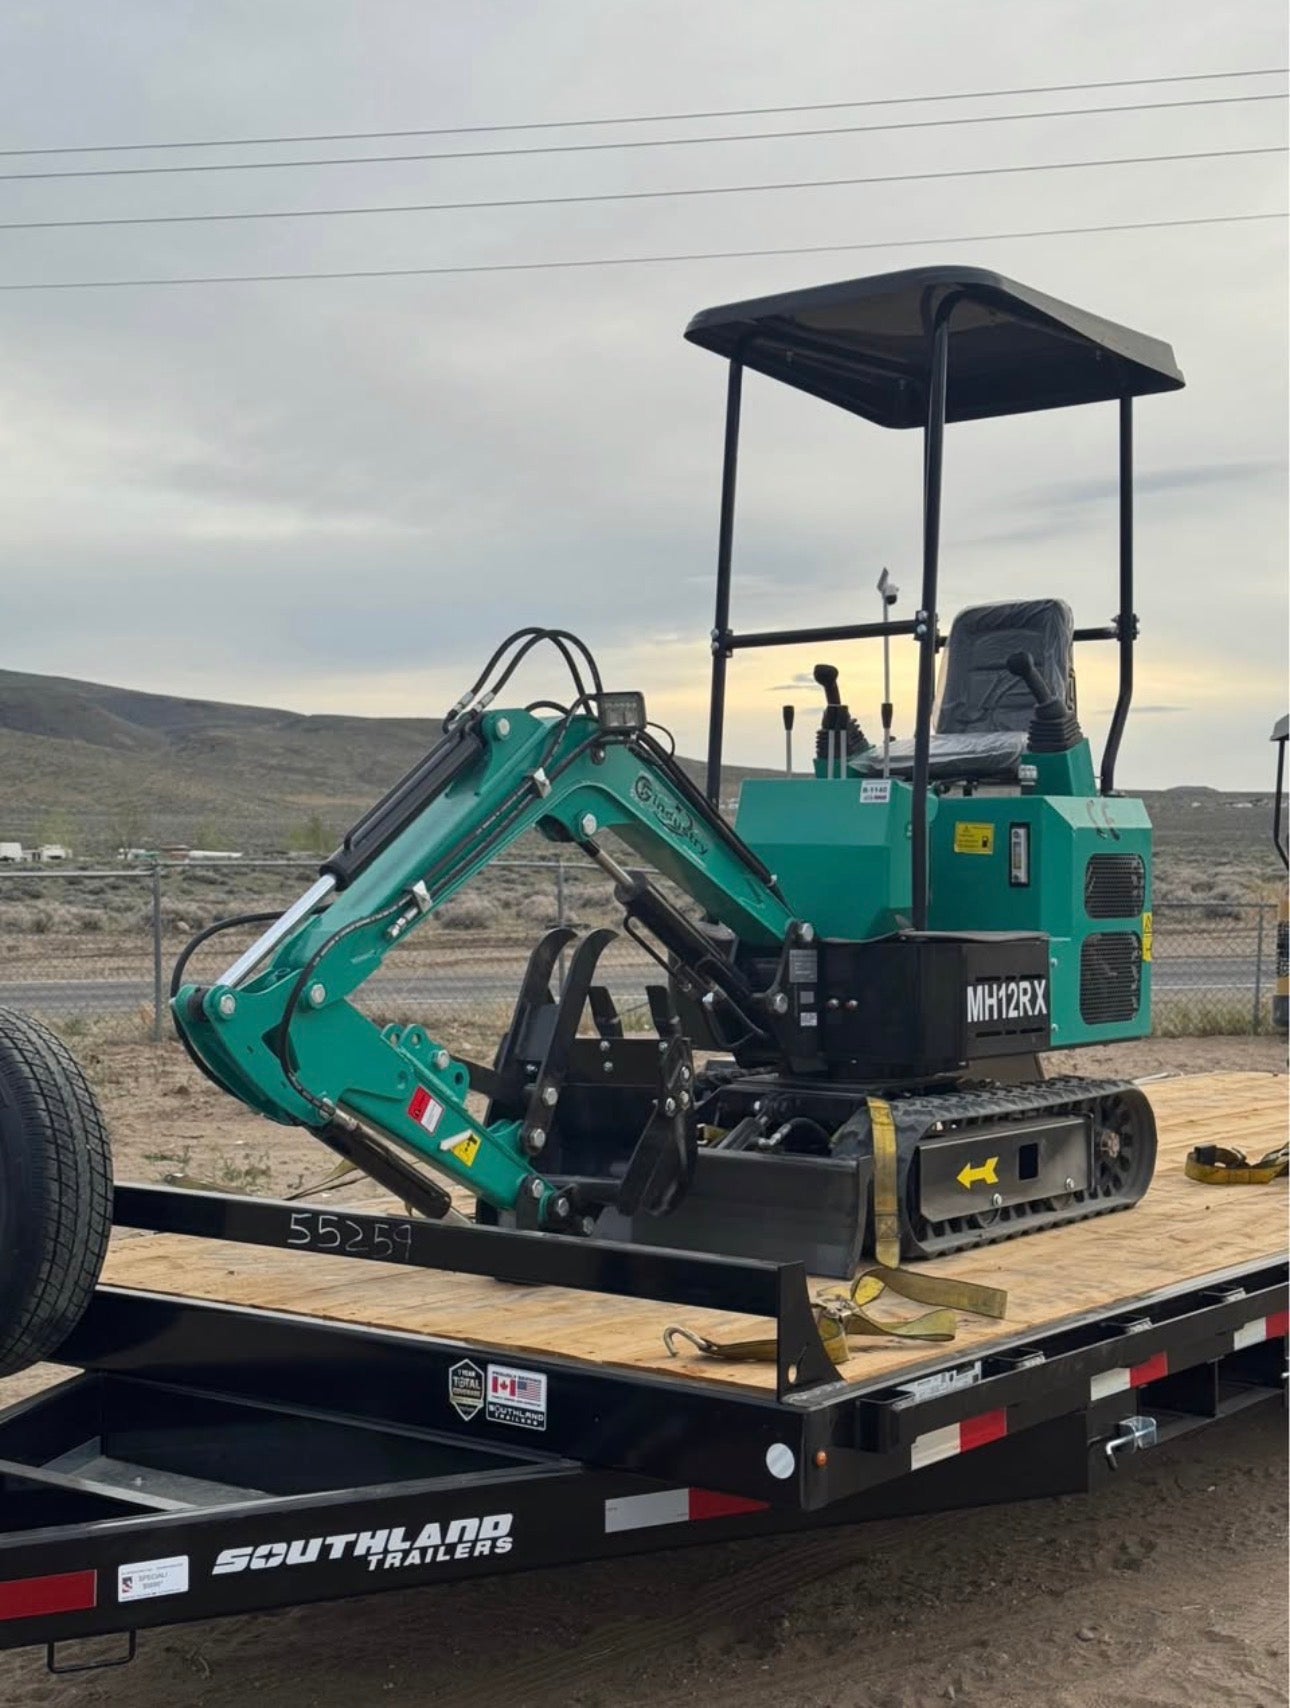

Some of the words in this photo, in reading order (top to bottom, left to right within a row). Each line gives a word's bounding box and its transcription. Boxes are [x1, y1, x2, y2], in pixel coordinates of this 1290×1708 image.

[967, 979, 1047, 1023] MH12RX
[286, 1212, 412, 1262] 55259
[452, 1376, 482, 1390] TOTAL
[488, 1404, 544, 1421] SOUTHLAND
[211, 1513, 514, 1576] SOUTHLAND
[367, 1536, 514, 1571] TRAILERS
